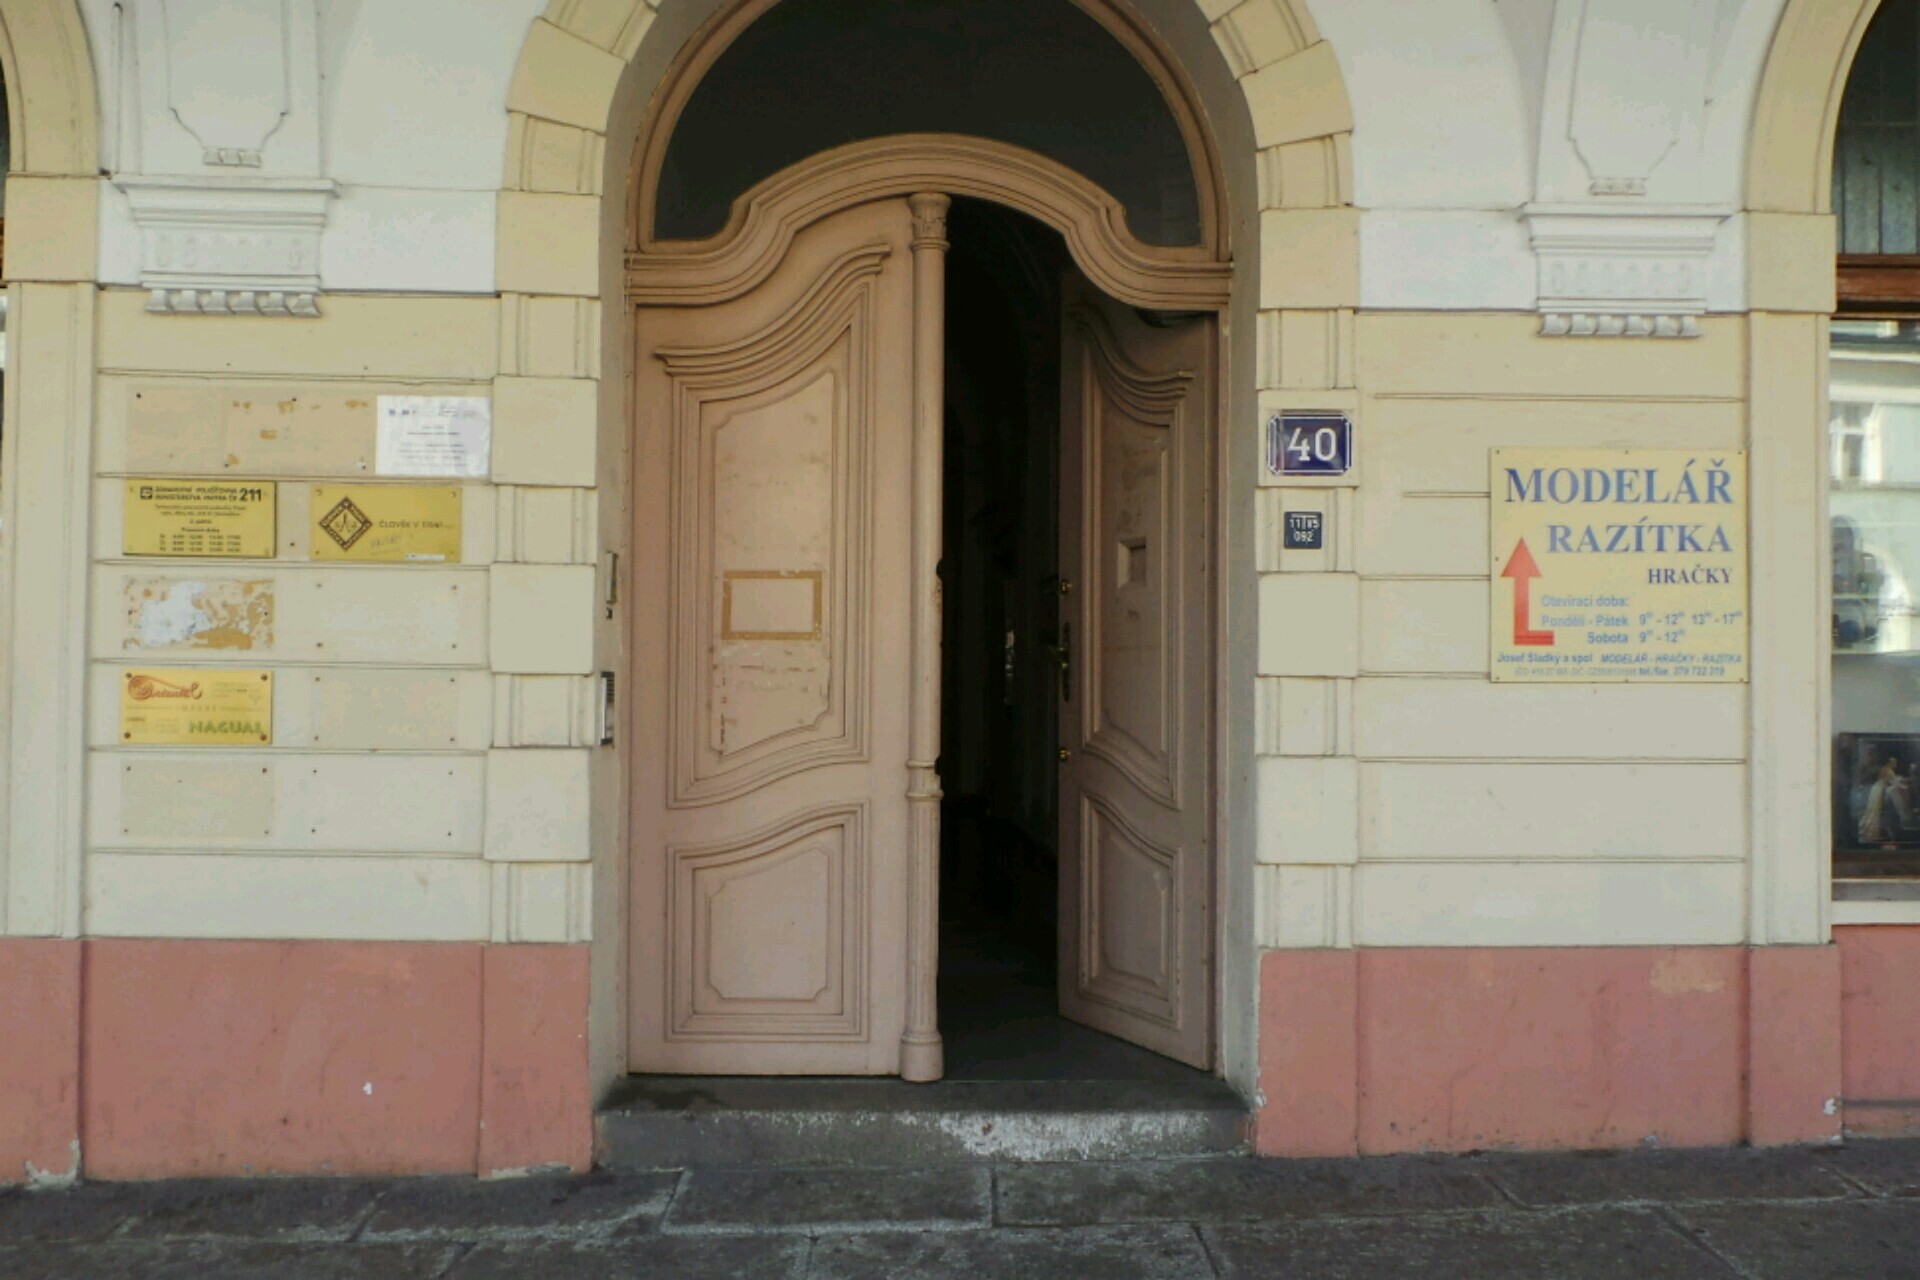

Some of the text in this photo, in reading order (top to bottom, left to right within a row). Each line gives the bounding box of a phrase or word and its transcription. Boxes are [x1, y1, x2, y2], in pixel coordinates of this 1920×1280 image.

[1288, 427, 1337, 461] 40
[1504, 458, 1733, 503] MODELÁŘ
[240, 487, 262, 502] 211
[379, 518, 410, 528] ČLOVĚK
[413, 520, 419, 528] V
[1547, 516, 1732, 552] RAZÍTKA
[1648, 564, 1733, 585] HRAČKY
[1541, 594, 1629, 607] Otevírací doba:
[1541, 613, 1585, 627] Pondělí
[1595, 613, 1628, 627] Pátek
[1587, 631, 1628, 644] Sobota
[1496, 652, 1525, 663] Josef
[1601, 652, 1648, 664] MODELÁŘ
[1656, 651, 1694, 664] HRAČKY
